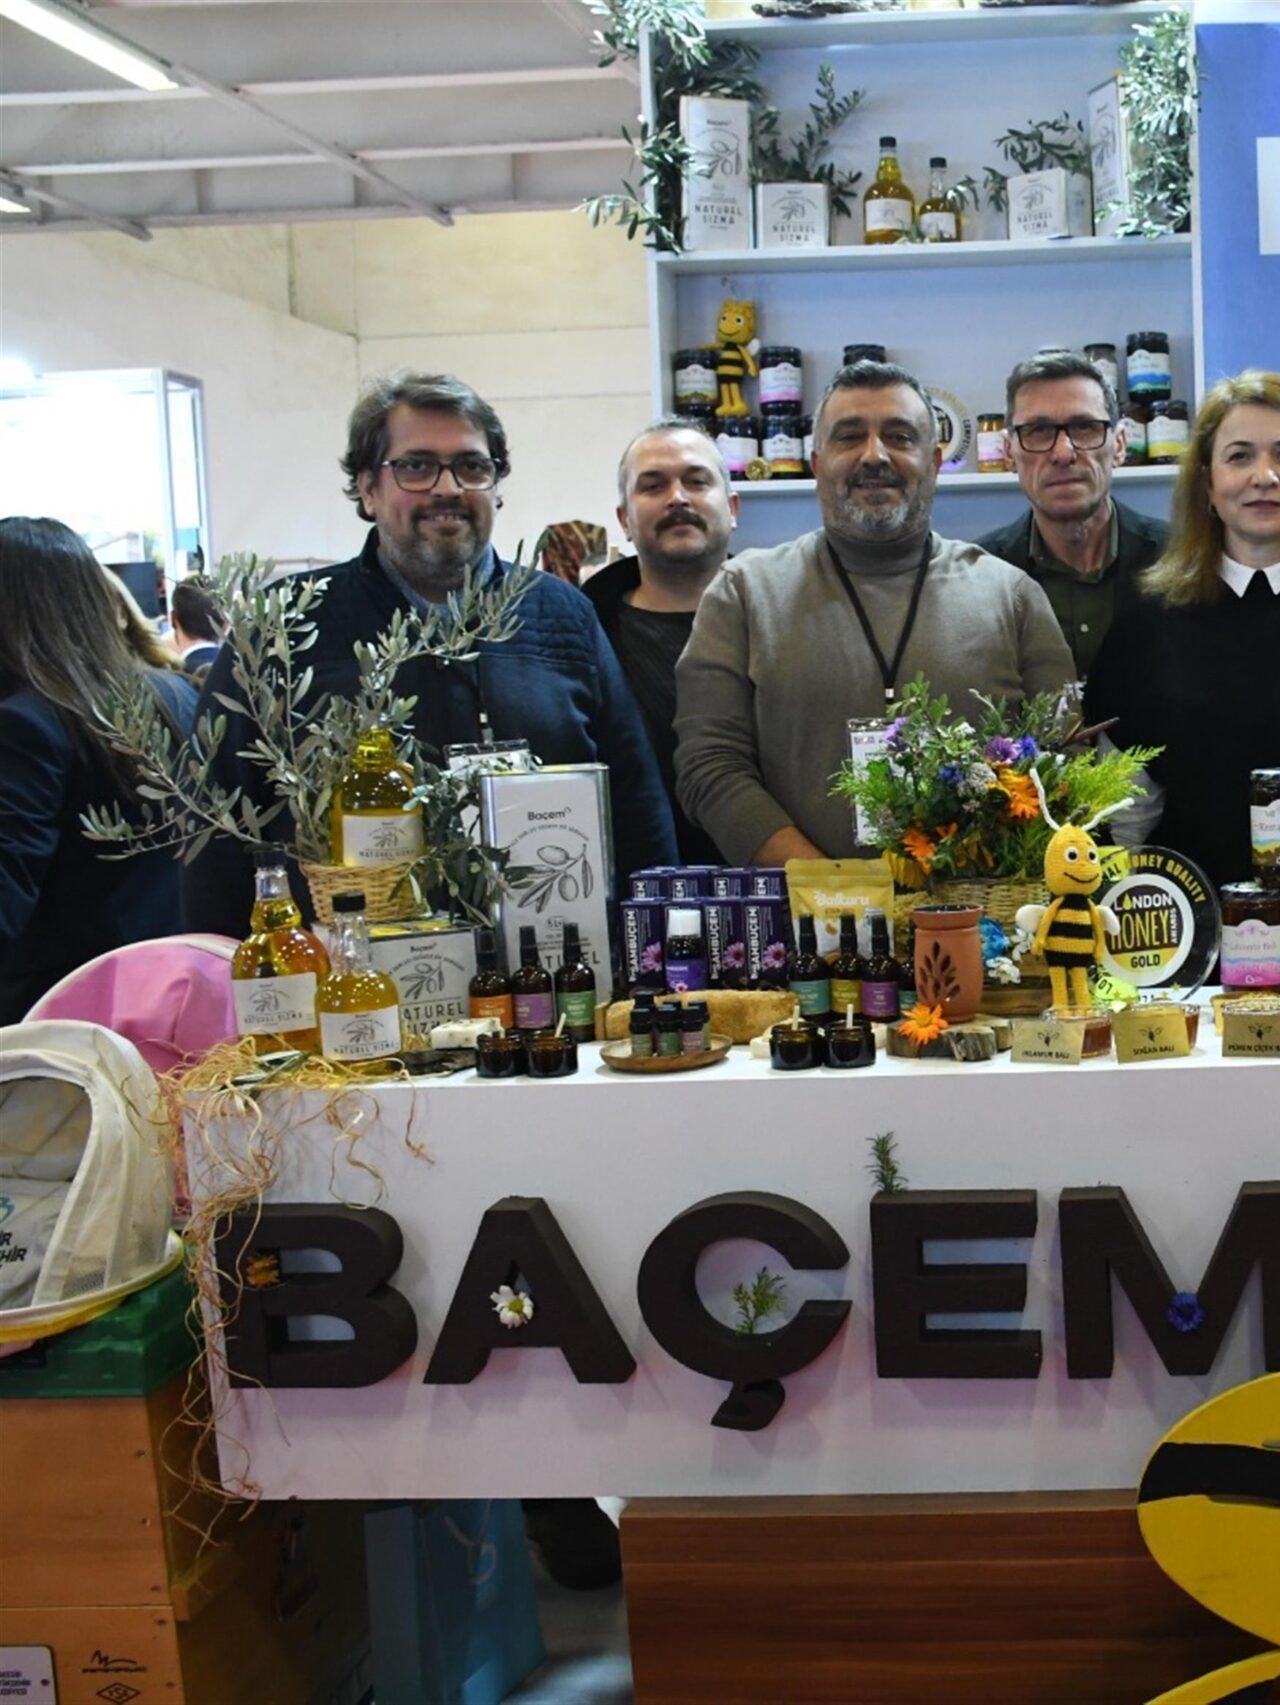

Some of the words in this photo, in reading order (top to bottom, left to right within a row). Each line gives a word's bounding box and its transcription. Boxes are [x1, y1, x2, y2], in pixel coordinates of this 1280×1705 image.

[695, 204, 743, 216] NATUREL
[1165, 859, 1207, 903] QUALITY
[1131, 954, 1161, 969] GOLD
